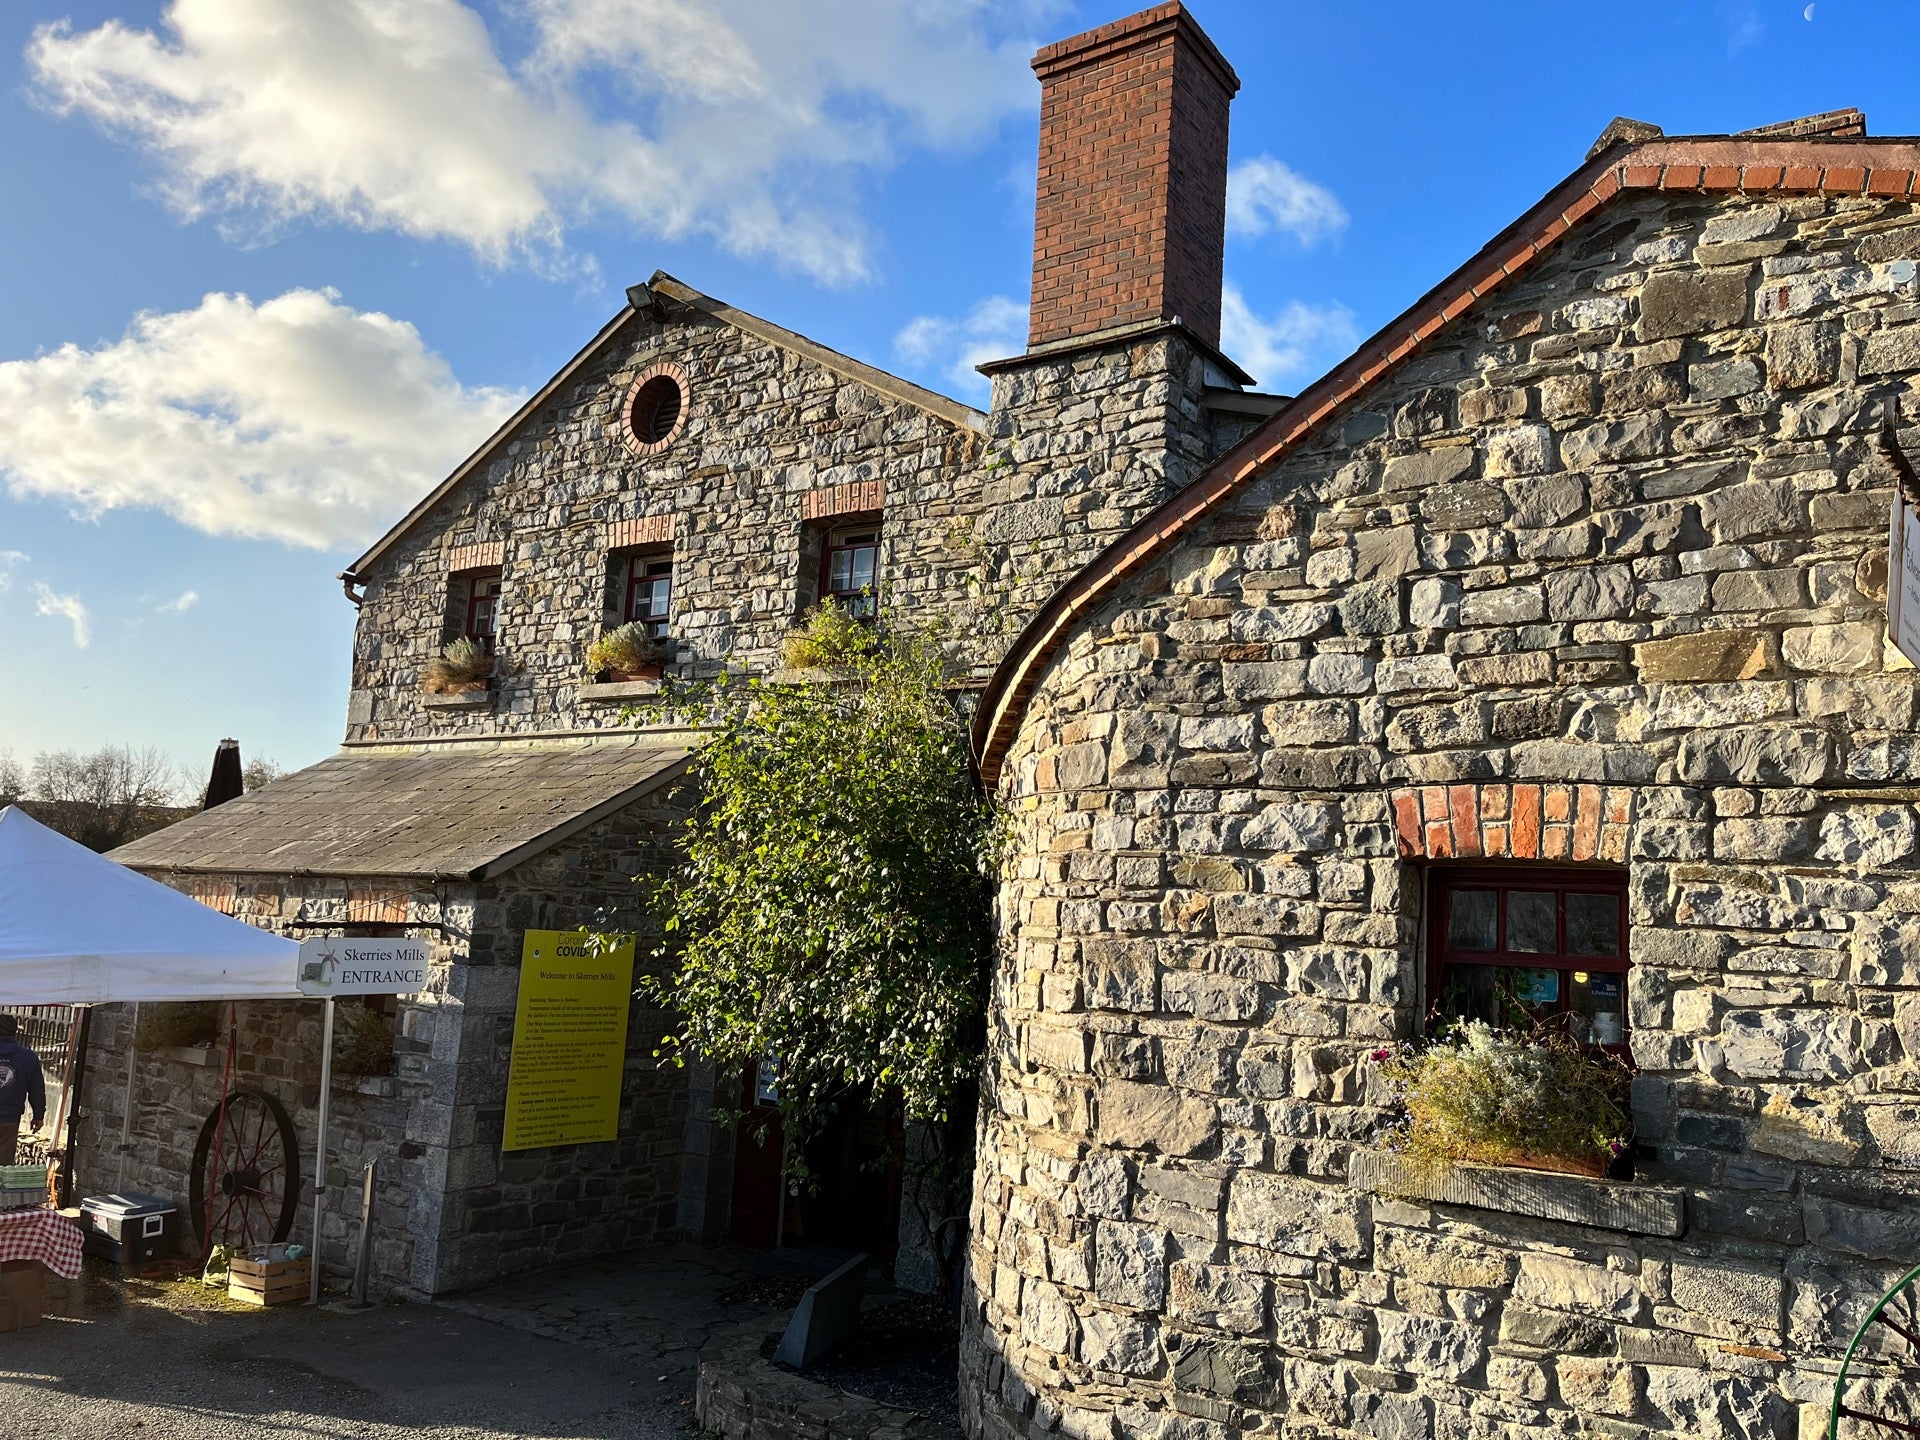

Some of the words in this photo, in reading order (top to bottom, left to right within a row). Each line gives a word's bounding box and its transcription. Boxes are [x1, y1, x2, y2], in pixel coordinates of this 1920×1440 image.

[344, 948, 392, 961] Skerries
[396, 948, 425, 961] Mills
[556, 946, 601, 957] COVID-
[341, 969, 423, 984] ENTRANCE
[540, 971, 566, 980] Welcome
[568, 972, 575, 980] to
[576, 971, 600, 981] Skerries
[601, 972, 616, 981] Mills
